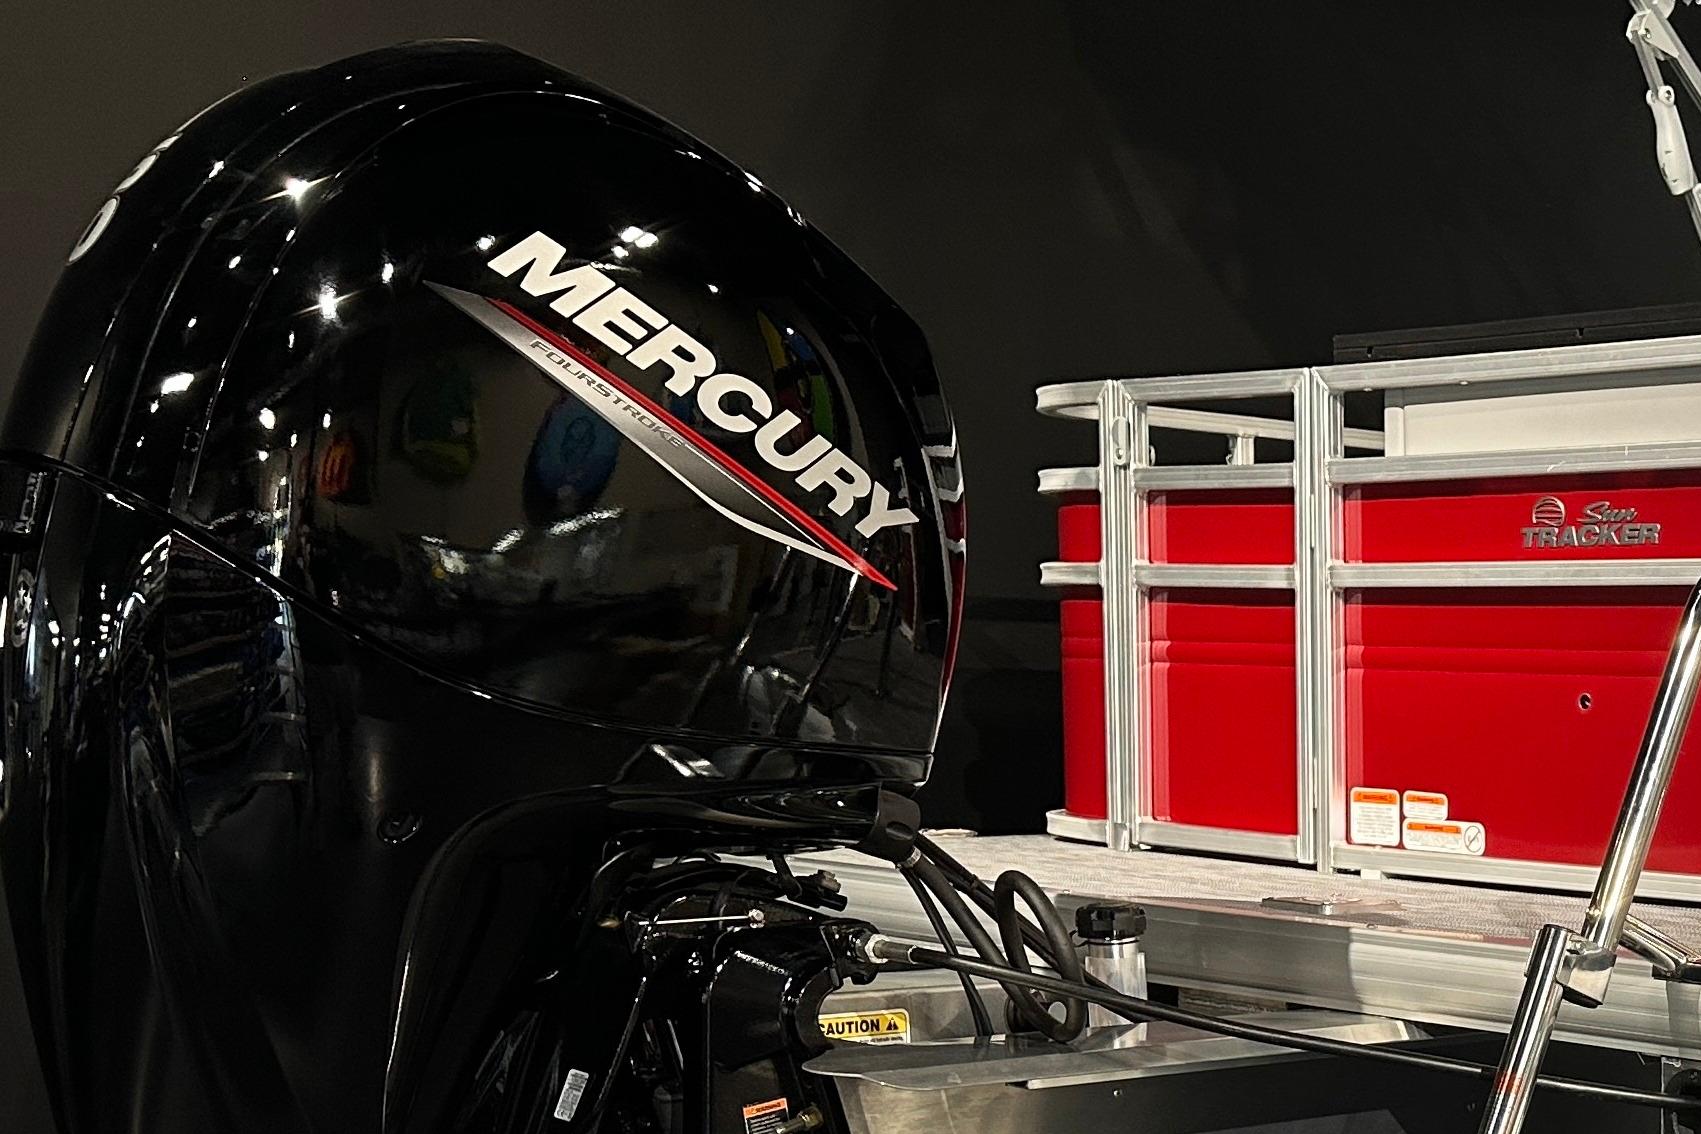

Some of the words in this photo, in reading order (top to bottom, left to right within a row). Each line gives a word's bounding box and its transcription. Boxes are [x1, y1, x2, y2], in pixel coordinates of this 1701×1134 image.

[487, 230, 919, 539] MERCURY
[529, 339, 684, 450] FOURSTROKE
[1523, 524, 1660, 548] TRACKER
[1578, 501, 1638, 523] Sun
